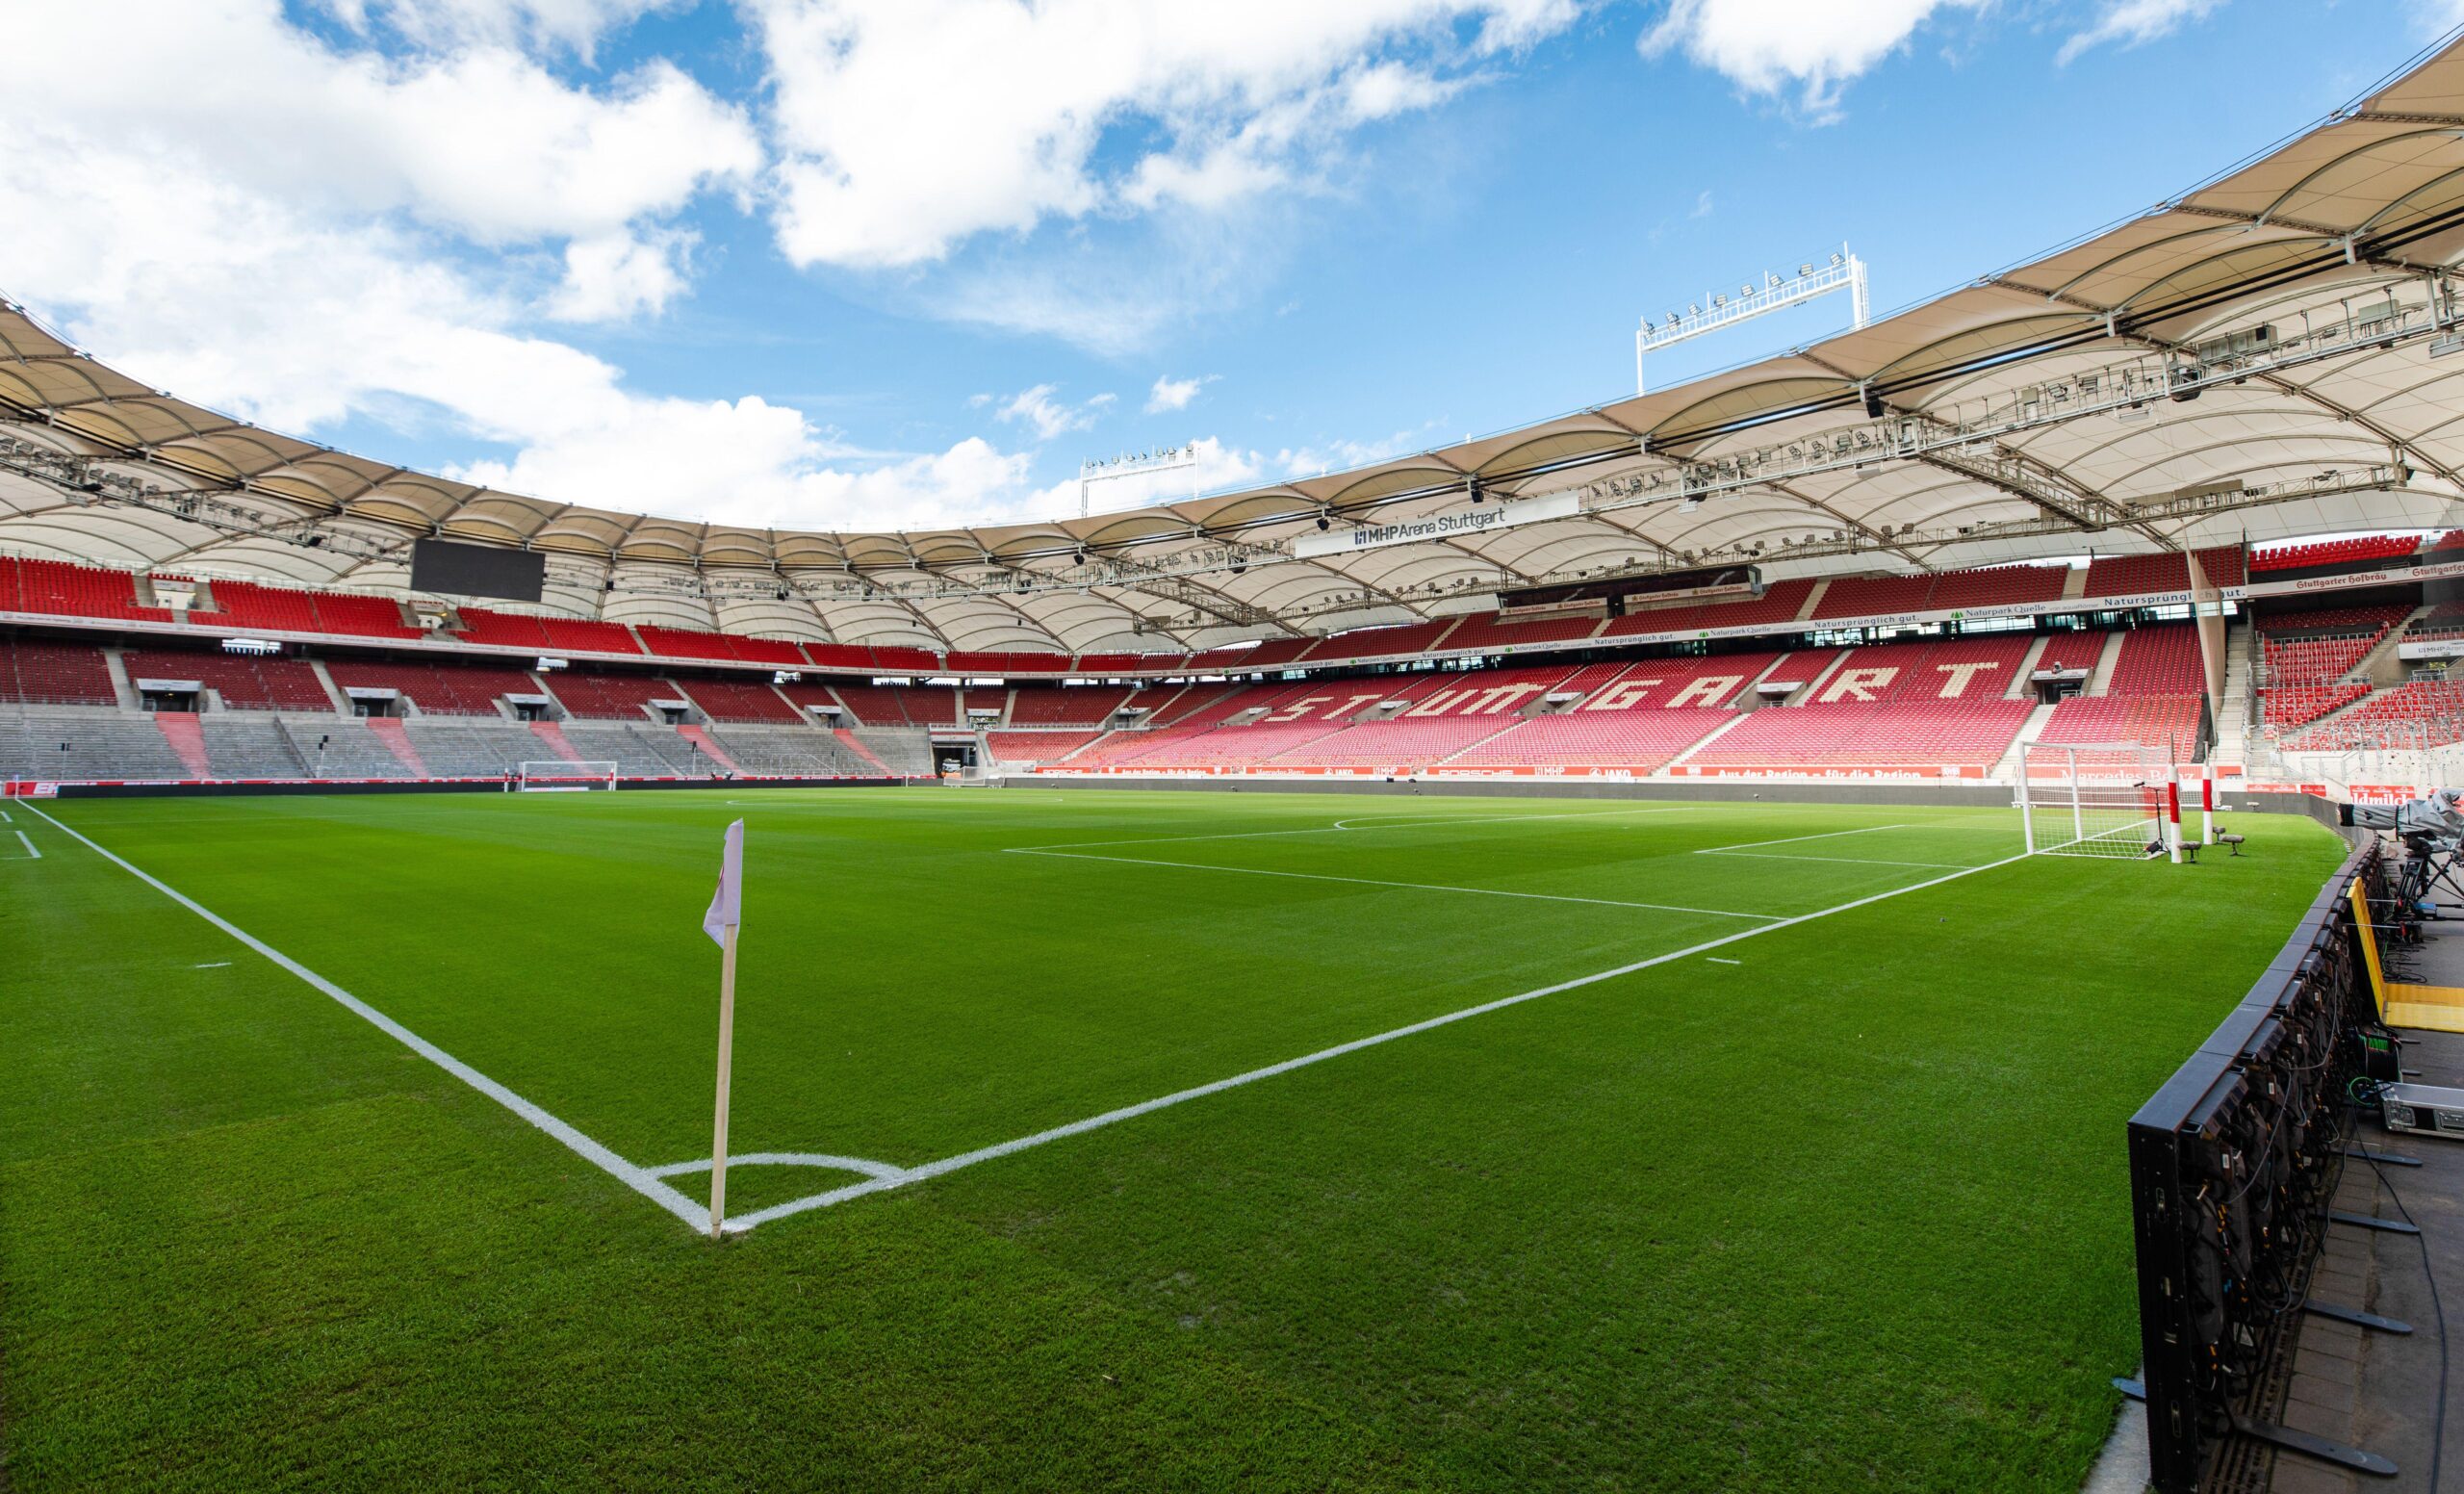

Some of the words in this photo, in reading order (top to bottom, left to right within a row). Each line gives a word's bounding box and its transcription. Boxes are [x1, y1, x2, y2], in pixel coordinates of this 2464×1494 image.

[1438, 507, 1505, 529] Stuttgart
[2412, 564, 2464, 577] Stuttgarte
[2297, 578, 2347, 589] Stuttgarter
[2348, 573, 2387, 583] Hofbräu
[1965, 606, 2014, 617] Naturpark
[2014, 604, 2046, 613] Quelle
[2104, 590, 2213, 606] Natursprünglch
[1710, 628, 1746, 636] Naturpark
[1814, 614, 1895, 629] Natursprünglich
[1899, 614, 1920, 623] gut.
[1595, 633, 1657, 645] Natursprünglich
[1422, 649, 1473, 658] Natursprünglich
[1545, 766, 1565, 775] MHP
[1604, 769, 1631, 778] JAKO
[1718, 769, 1740, 778] Aus
[1743, 769, 1762, 778] der
[1849, 769, 1870, 778] die
